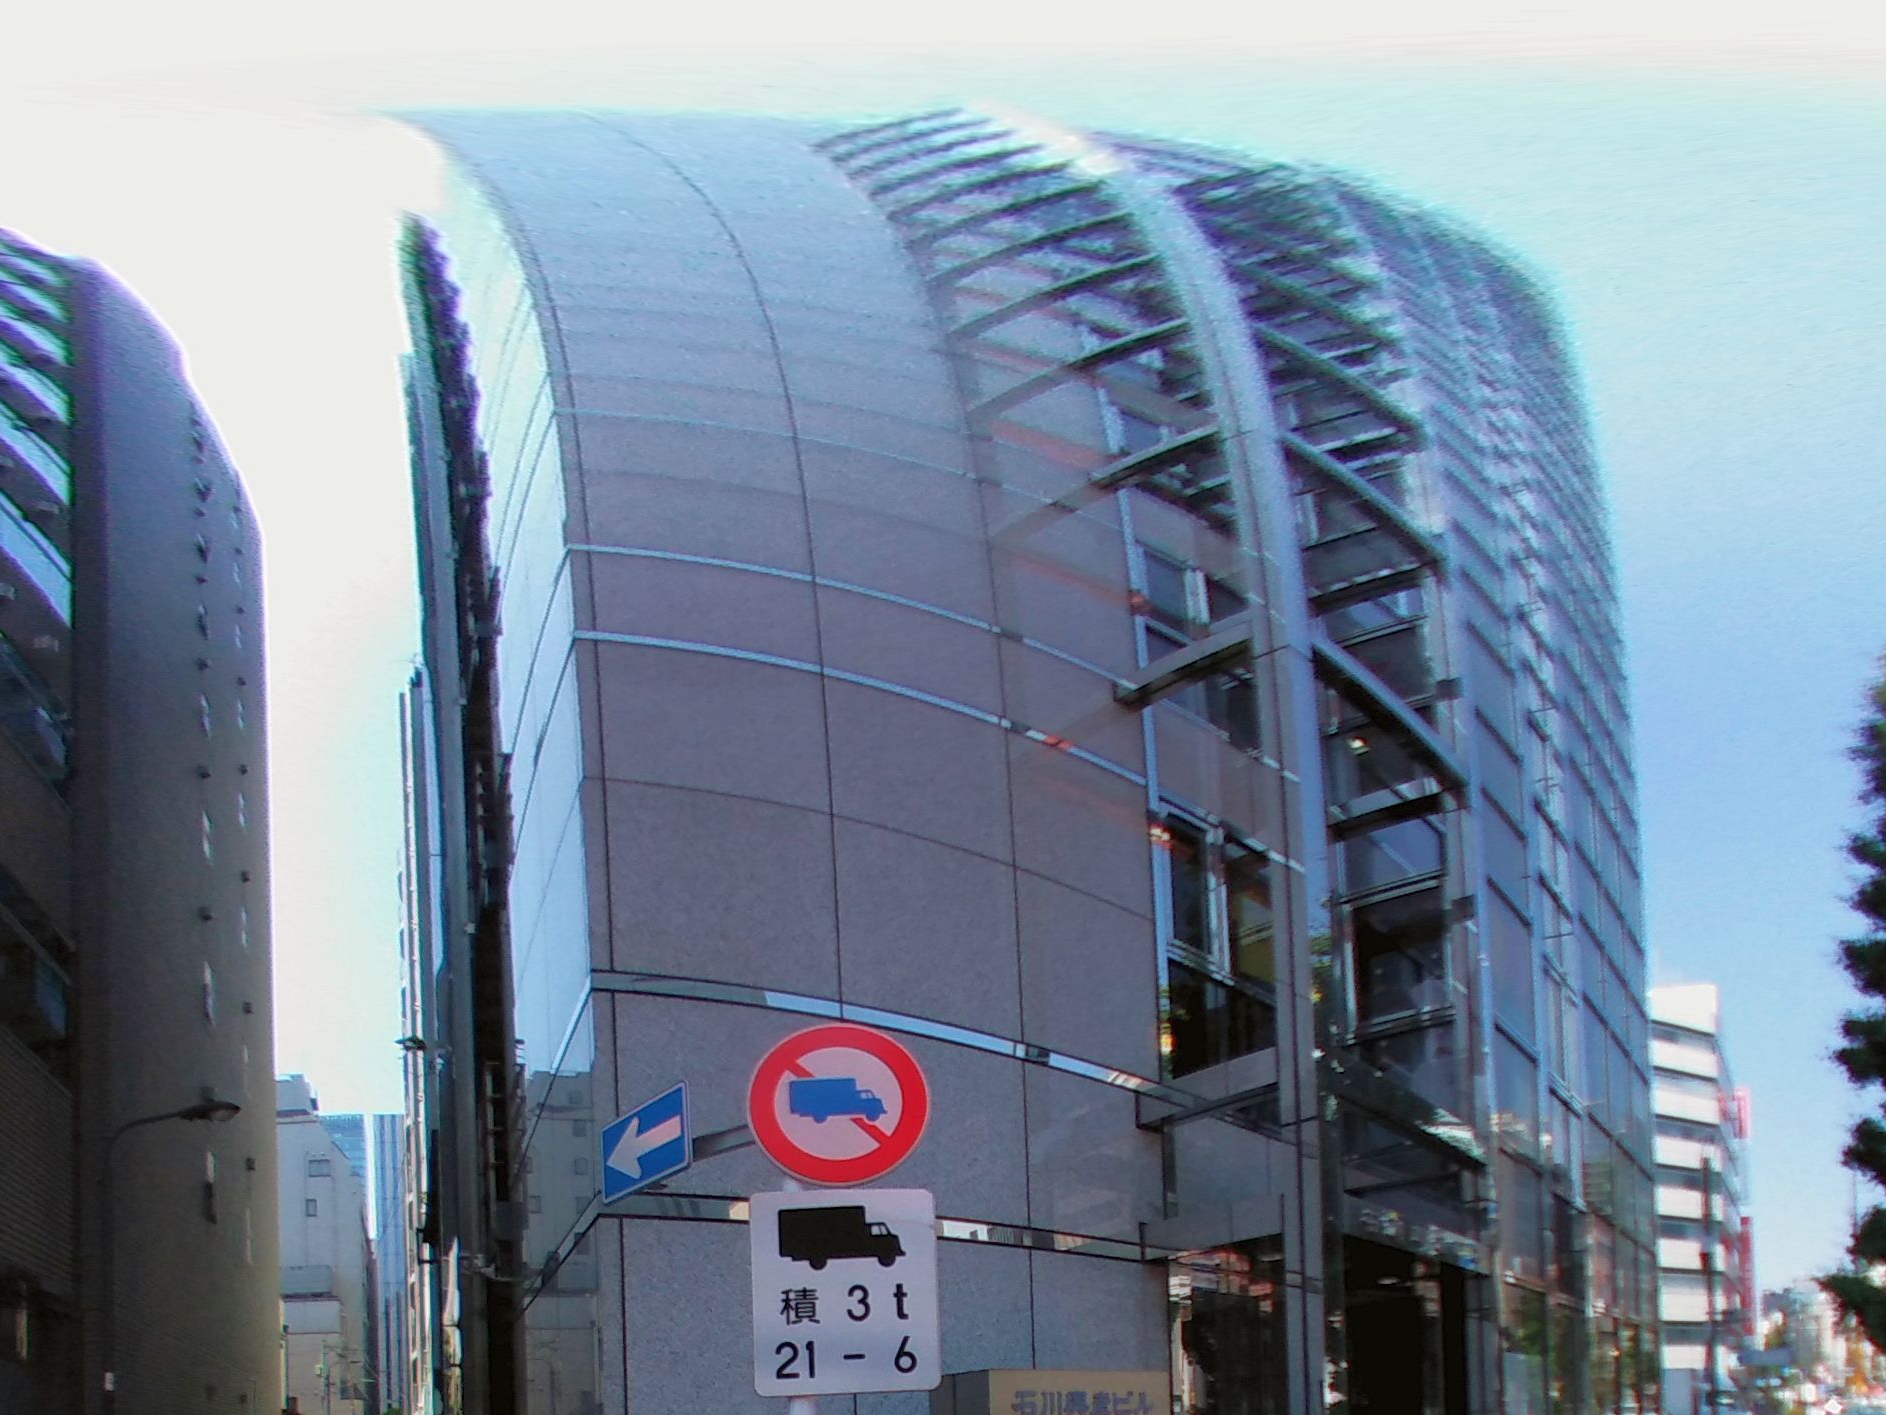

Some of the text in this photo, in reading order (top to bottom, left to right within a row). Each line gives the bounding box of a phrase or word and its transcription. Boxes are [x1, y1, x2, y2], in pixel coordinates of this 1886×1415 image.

[780, 1283, 909, 1326] 積 3 t
[775, 1340, 816, 1380] 21
[894, 1335, 918, 1374] 6
